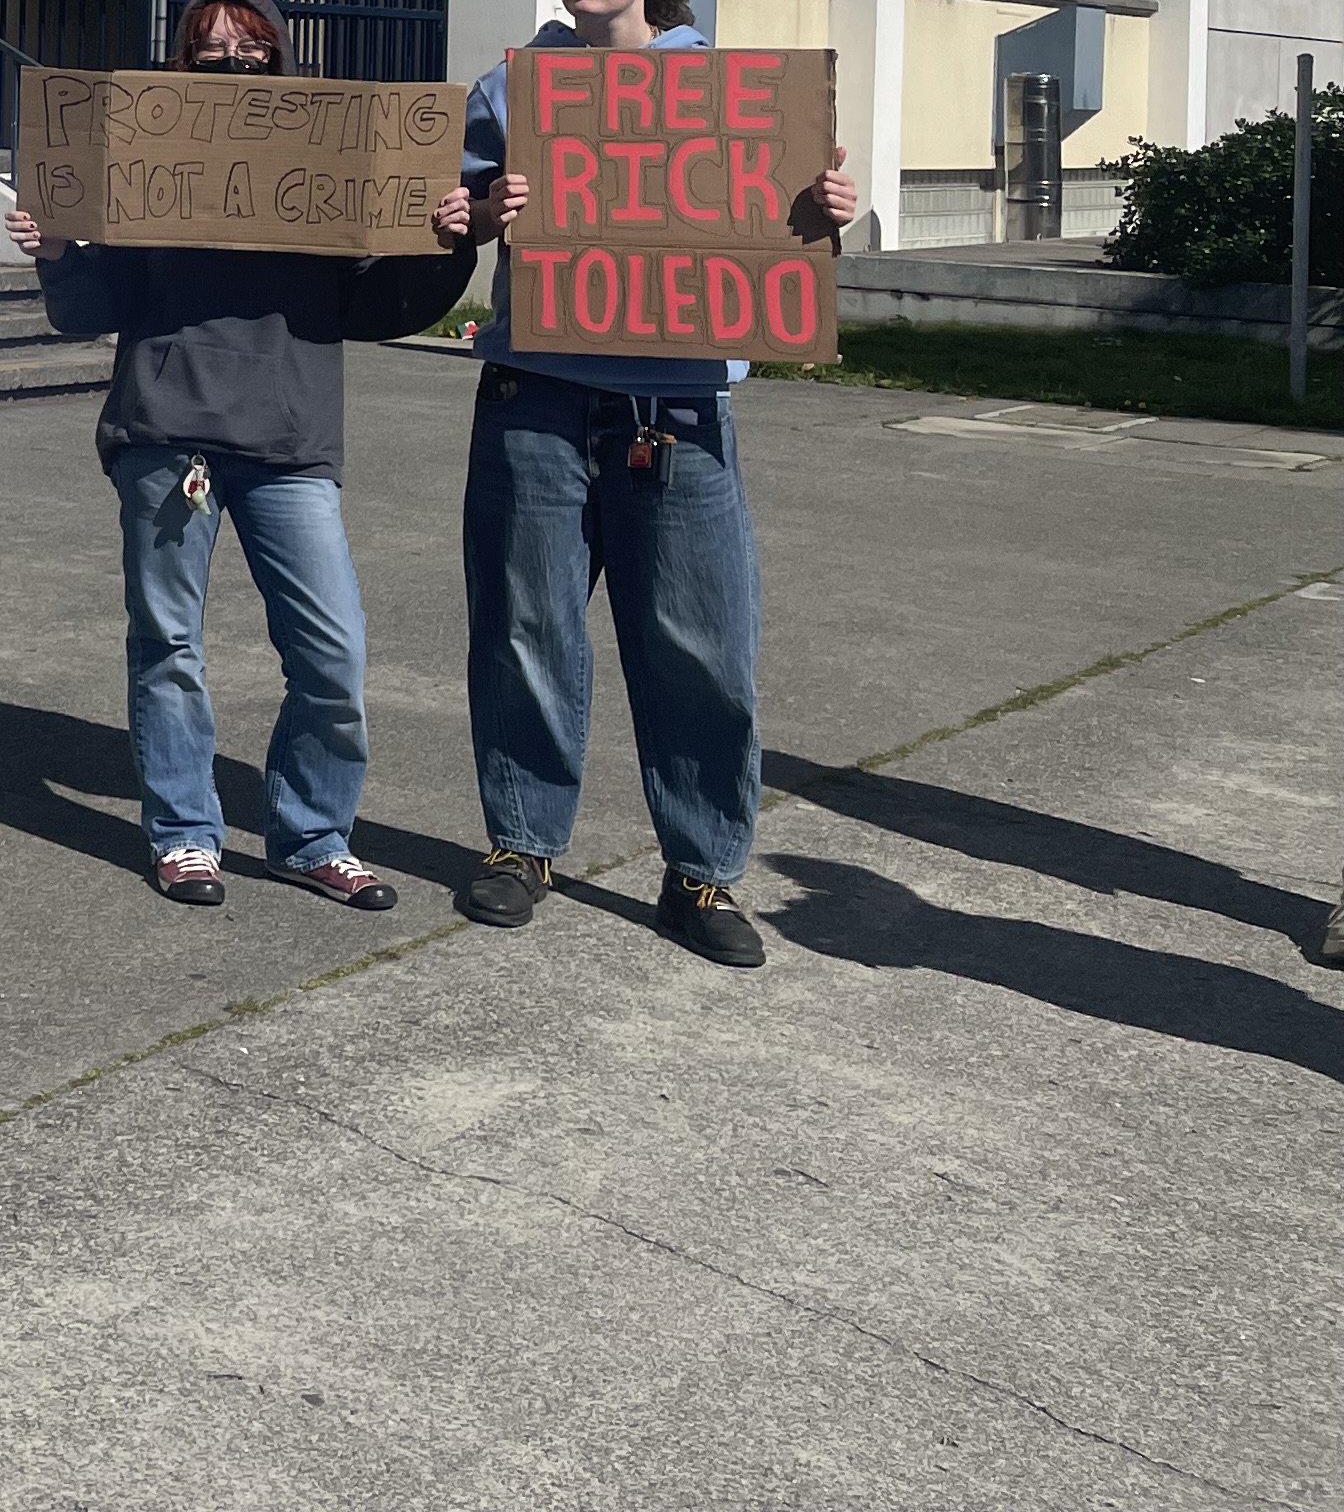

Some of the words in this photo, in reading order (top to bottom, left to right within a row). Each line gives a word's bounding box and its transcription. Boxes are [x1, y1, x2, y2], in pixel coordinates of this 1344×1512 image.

[42, 75, 449, 154] PROTESTING
[537, 52, 782, 134] FREE
[35, 161, 85, 219] IS
[107, 159, 205, 224] NOT
[223, 161, 255, 219] A
[275, 167, 428, 228] CRIME
[551, 136, 780, 229] RICK
[521, 248, 817, 344] TOLEDO
